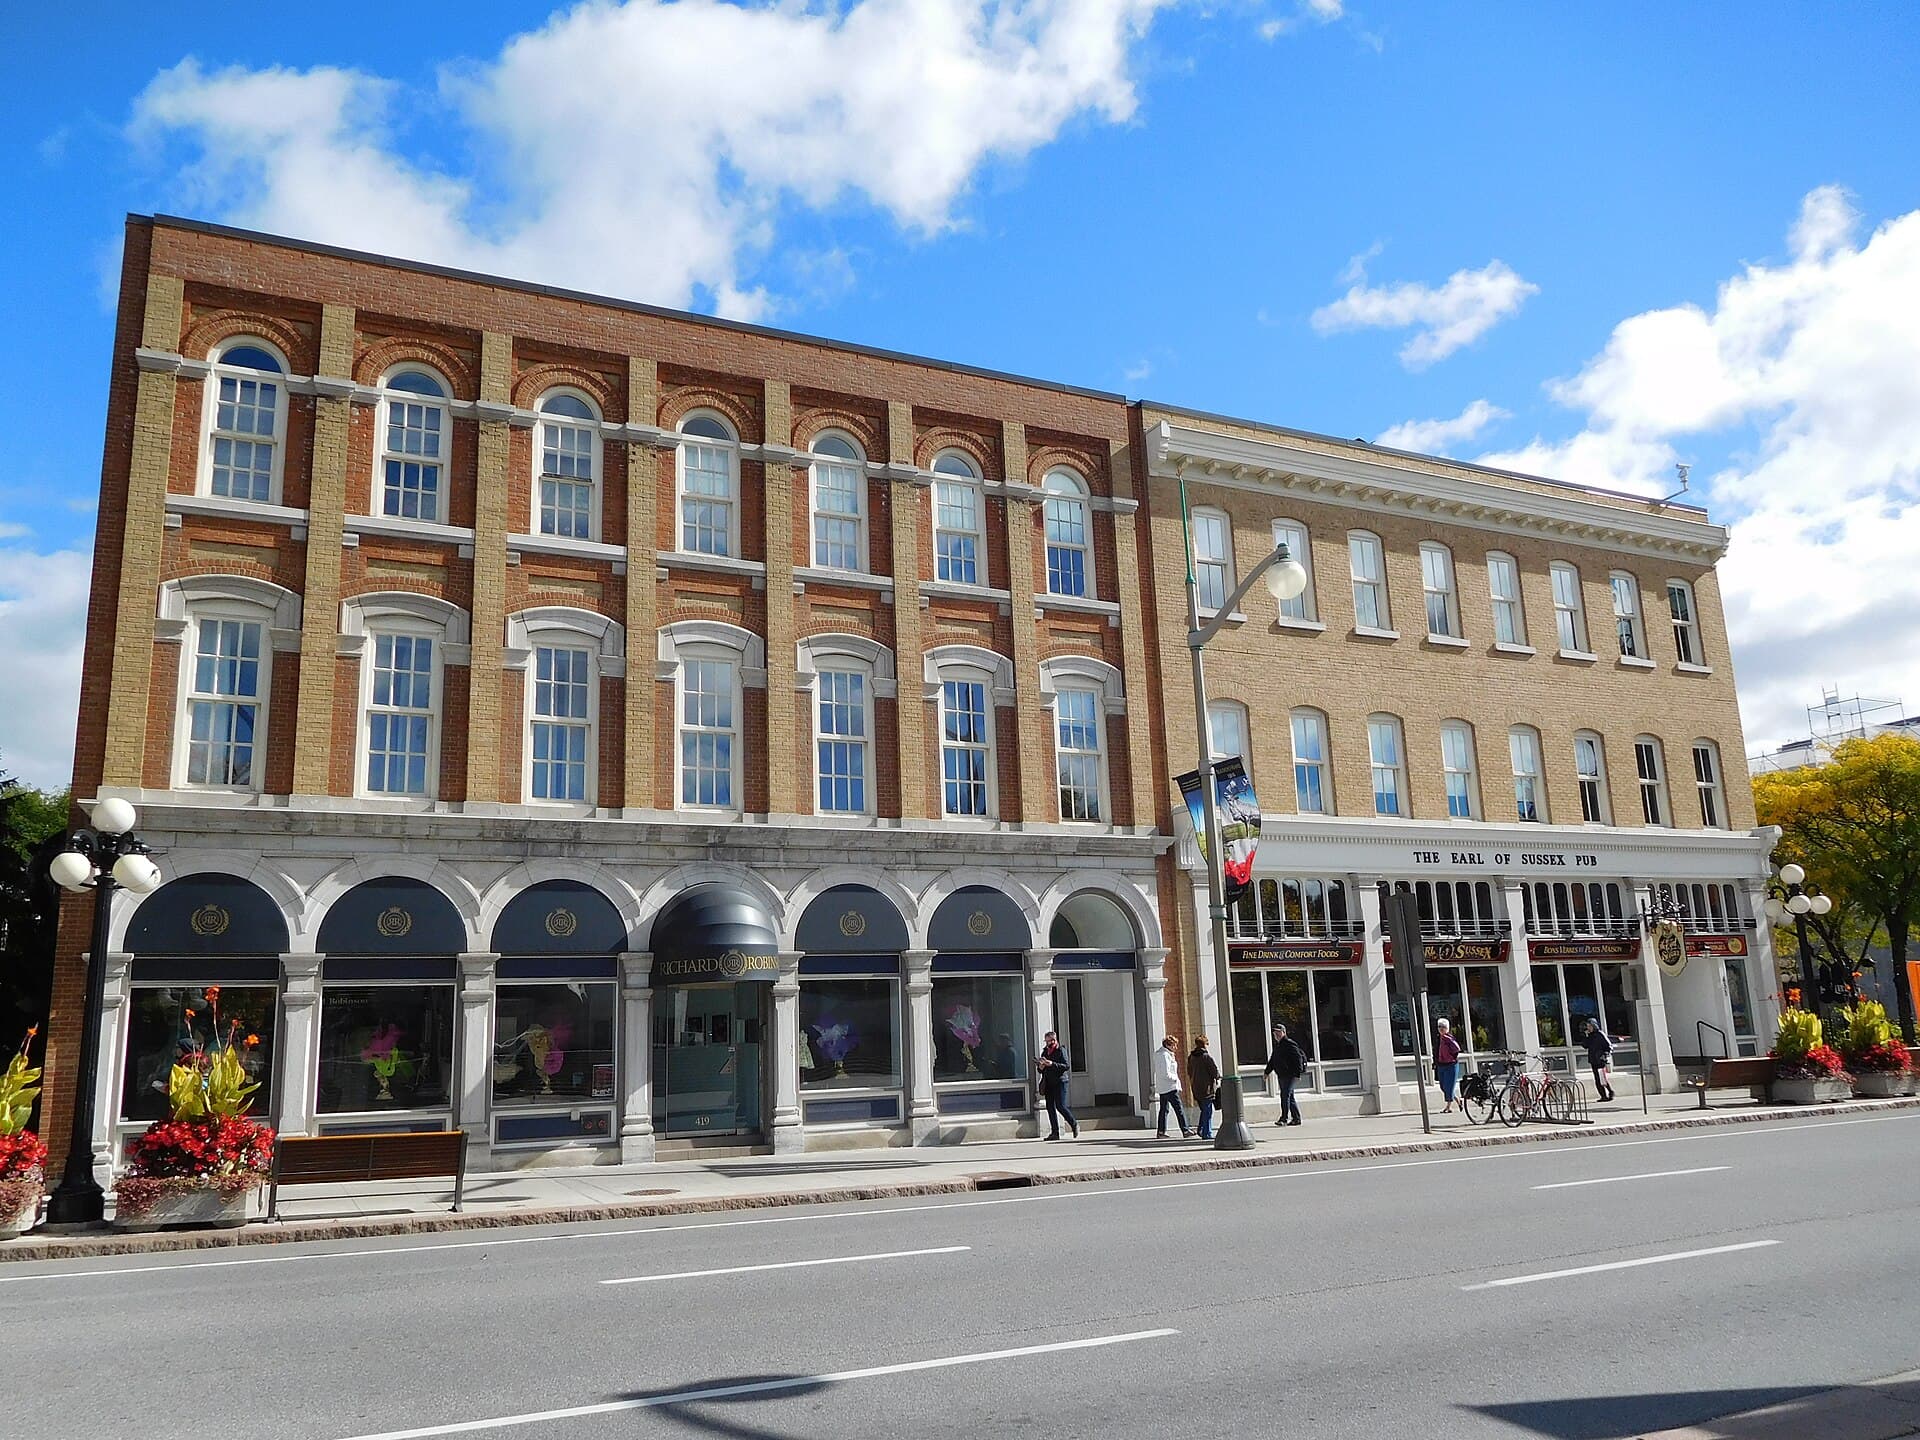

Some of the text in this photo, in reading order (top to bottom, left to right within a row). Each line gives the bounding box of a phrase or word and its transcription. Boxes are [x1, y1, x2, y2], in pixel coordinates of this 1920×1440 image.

[1413, 851, 1597, 866] THE EARL OF SUSSEX PUB
[1242, 950, 1257, 959] FINE
[1258, 950, 1279, 959] DRINK
[1285, 949, 1317, 959] COMFORT
[1317, 949, 1340, 958] FOODS
[660, 958, 719, 975] RICHARD
[695, 1116, 710, 1126] 419
